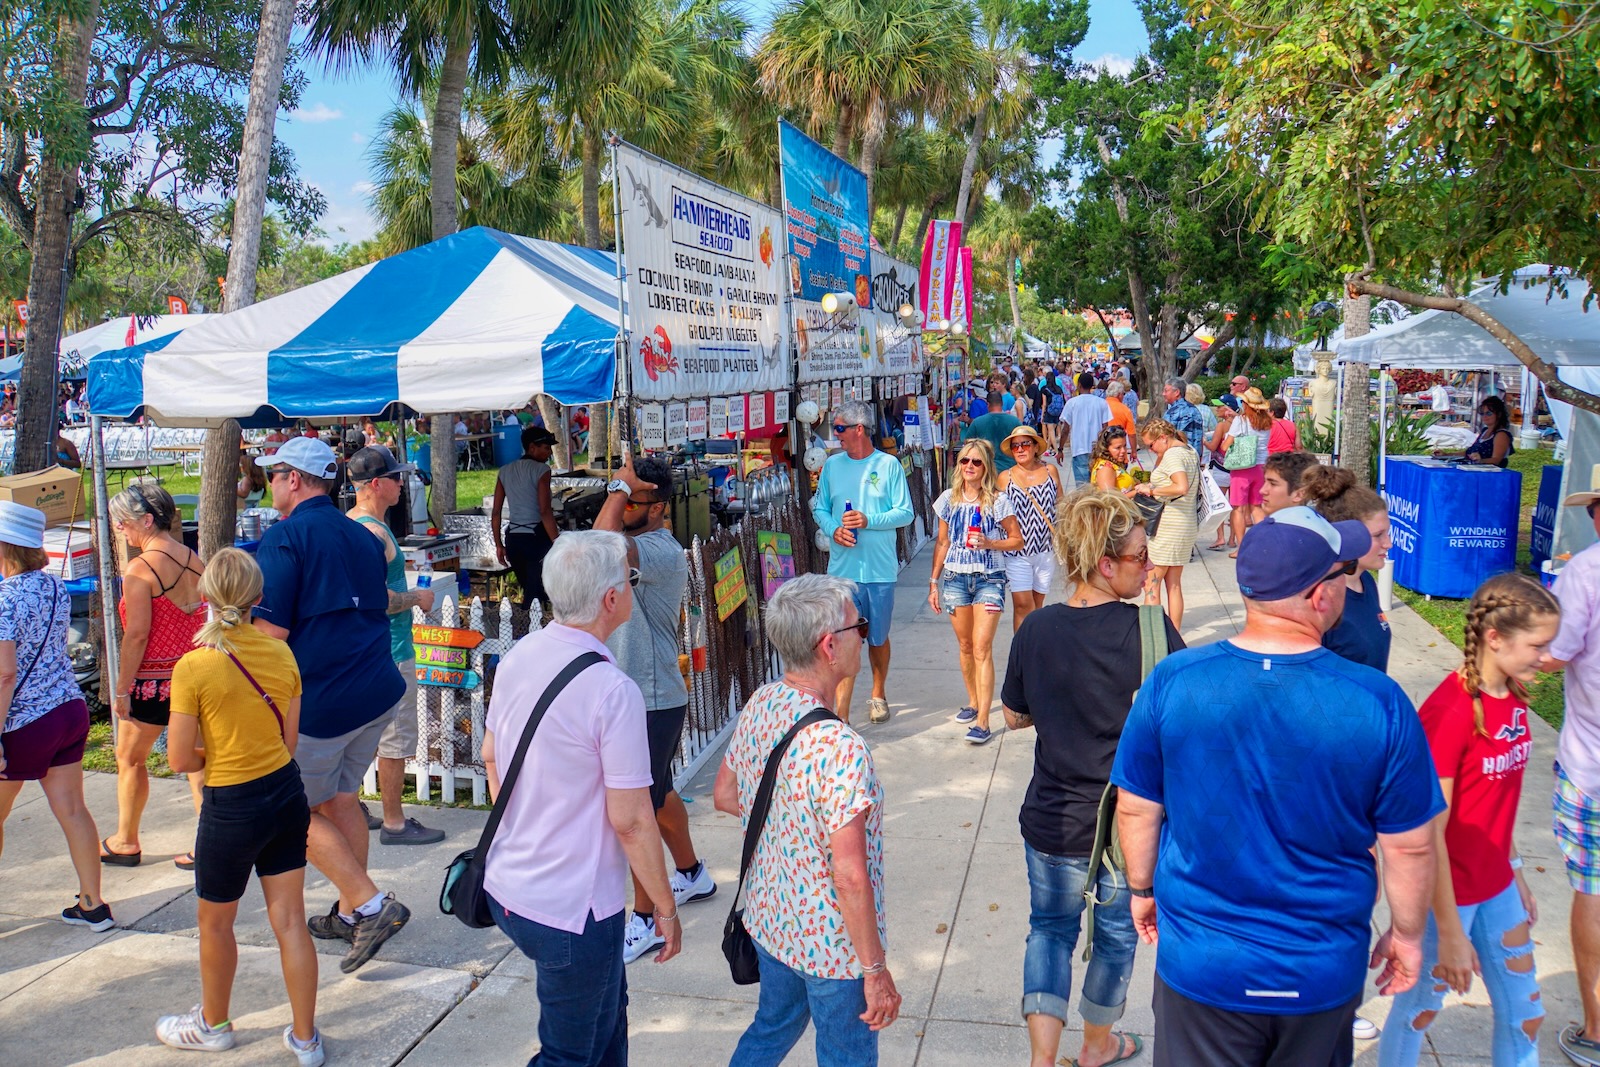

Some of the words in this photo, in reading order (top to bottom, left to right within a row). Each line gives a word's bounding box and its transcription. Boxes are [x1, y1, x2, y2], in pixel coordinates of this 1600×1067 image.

[673, 194, 750, 241] HAMMERHEADS
[700, 231, 733, 252] SEAFOOD
[935, 227, 946, 261] ICE
[675, 252, 711, 275] SEAFOOD
[713, 263, 756, 284] JAMBALAYA
[639, 268, 680, 291] COCONUT
[684, 278, 713, 297] SHRIMP
[727, 287, 752, 303] GARLIC
[874, 275, 910, 311] GROUPER
[929, 268, 941, 323] CREAM
[648, 291, 688, 314] LOBSTER
[689, 300, 715, 317] CAKES
[729, 305, 762, 321] SCALLOPS
[688, 324, 723, 341] GROUPER
[726, 327, 758, 342] NUGGETS
[684, 358, 720, 374] SEAFOOD
[723, 358, 759, 373] PLATTERS
[647, 412, 659, 424] FRIED
[643, 428, 663, 439] OYSTERS
[1450, 527, 1507, 536] WYNDHAM
[1450, 540, 1506, 548] REWARDS
[421, 627, 452, 643] WEST
[420, 645, 427, 659] 3
[429, 648, 464, 664] MILES
[431, 669, 464, 685] PARTY
